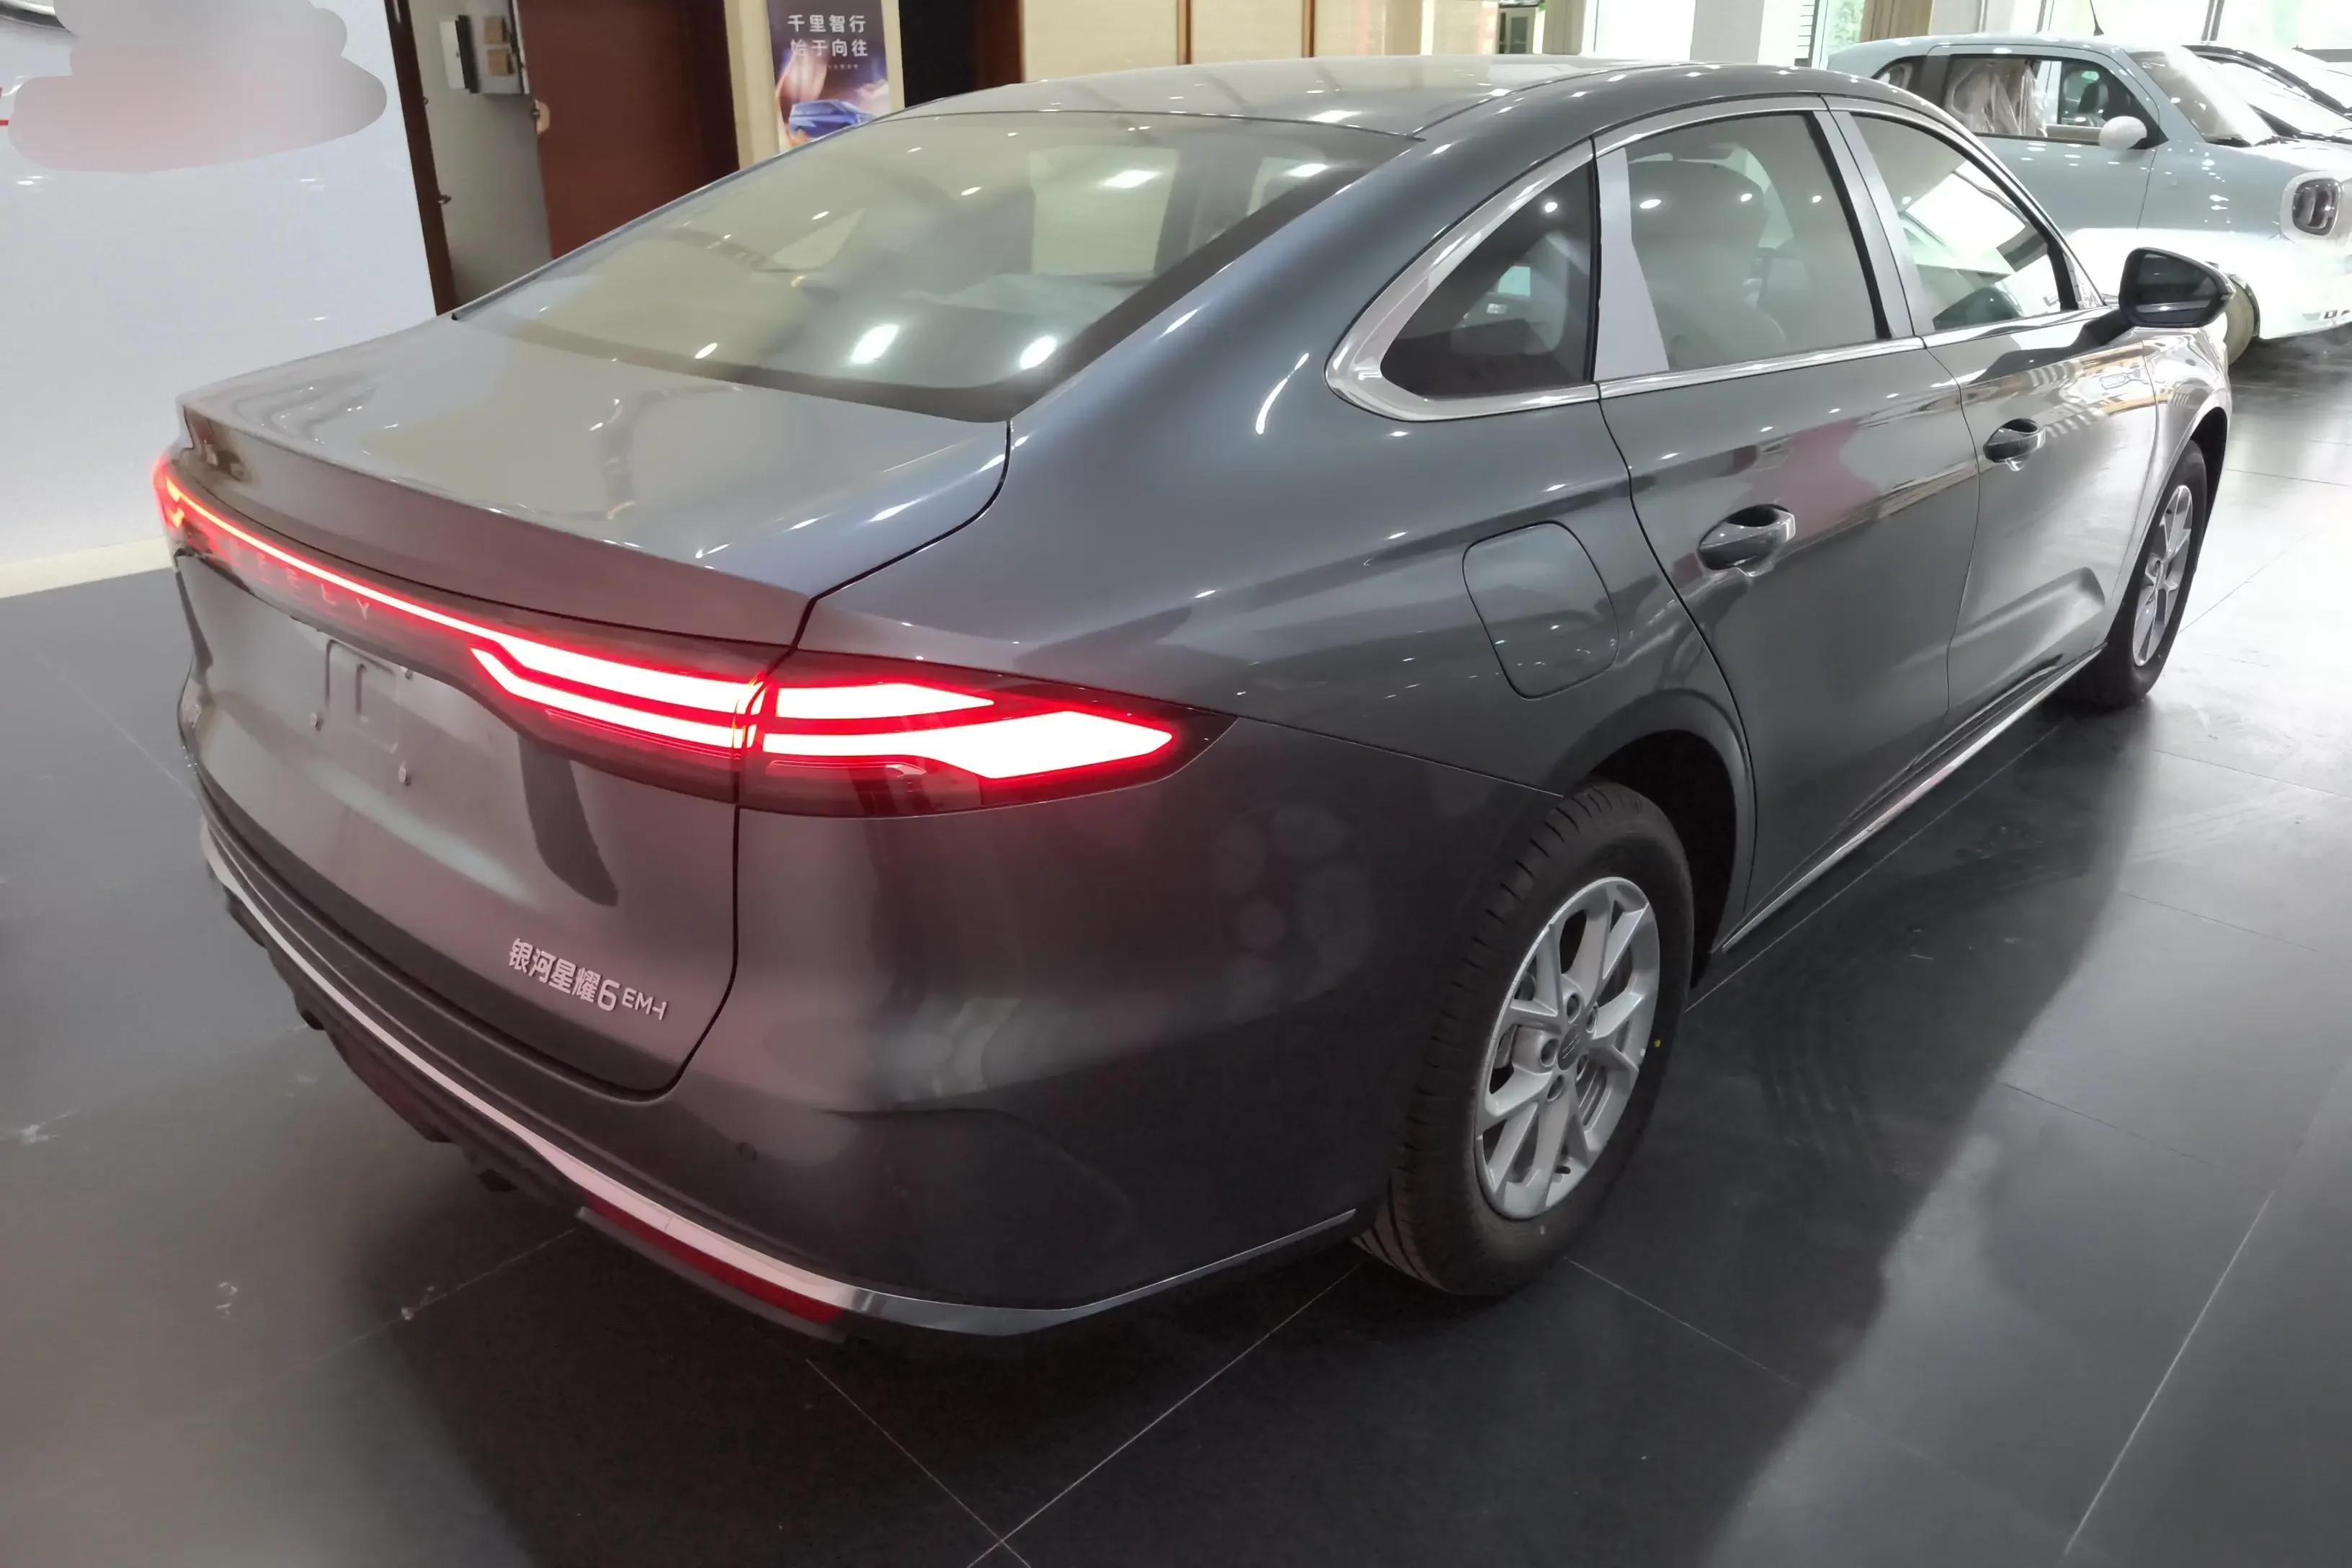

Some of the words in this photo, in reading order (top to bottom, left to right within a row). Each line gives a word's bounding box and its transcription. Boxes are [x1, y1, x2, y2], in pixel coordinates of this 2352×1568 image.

[788, 14, 866, 33] 千里智行
[509, 937, 620, 1012] 银河星耀6
